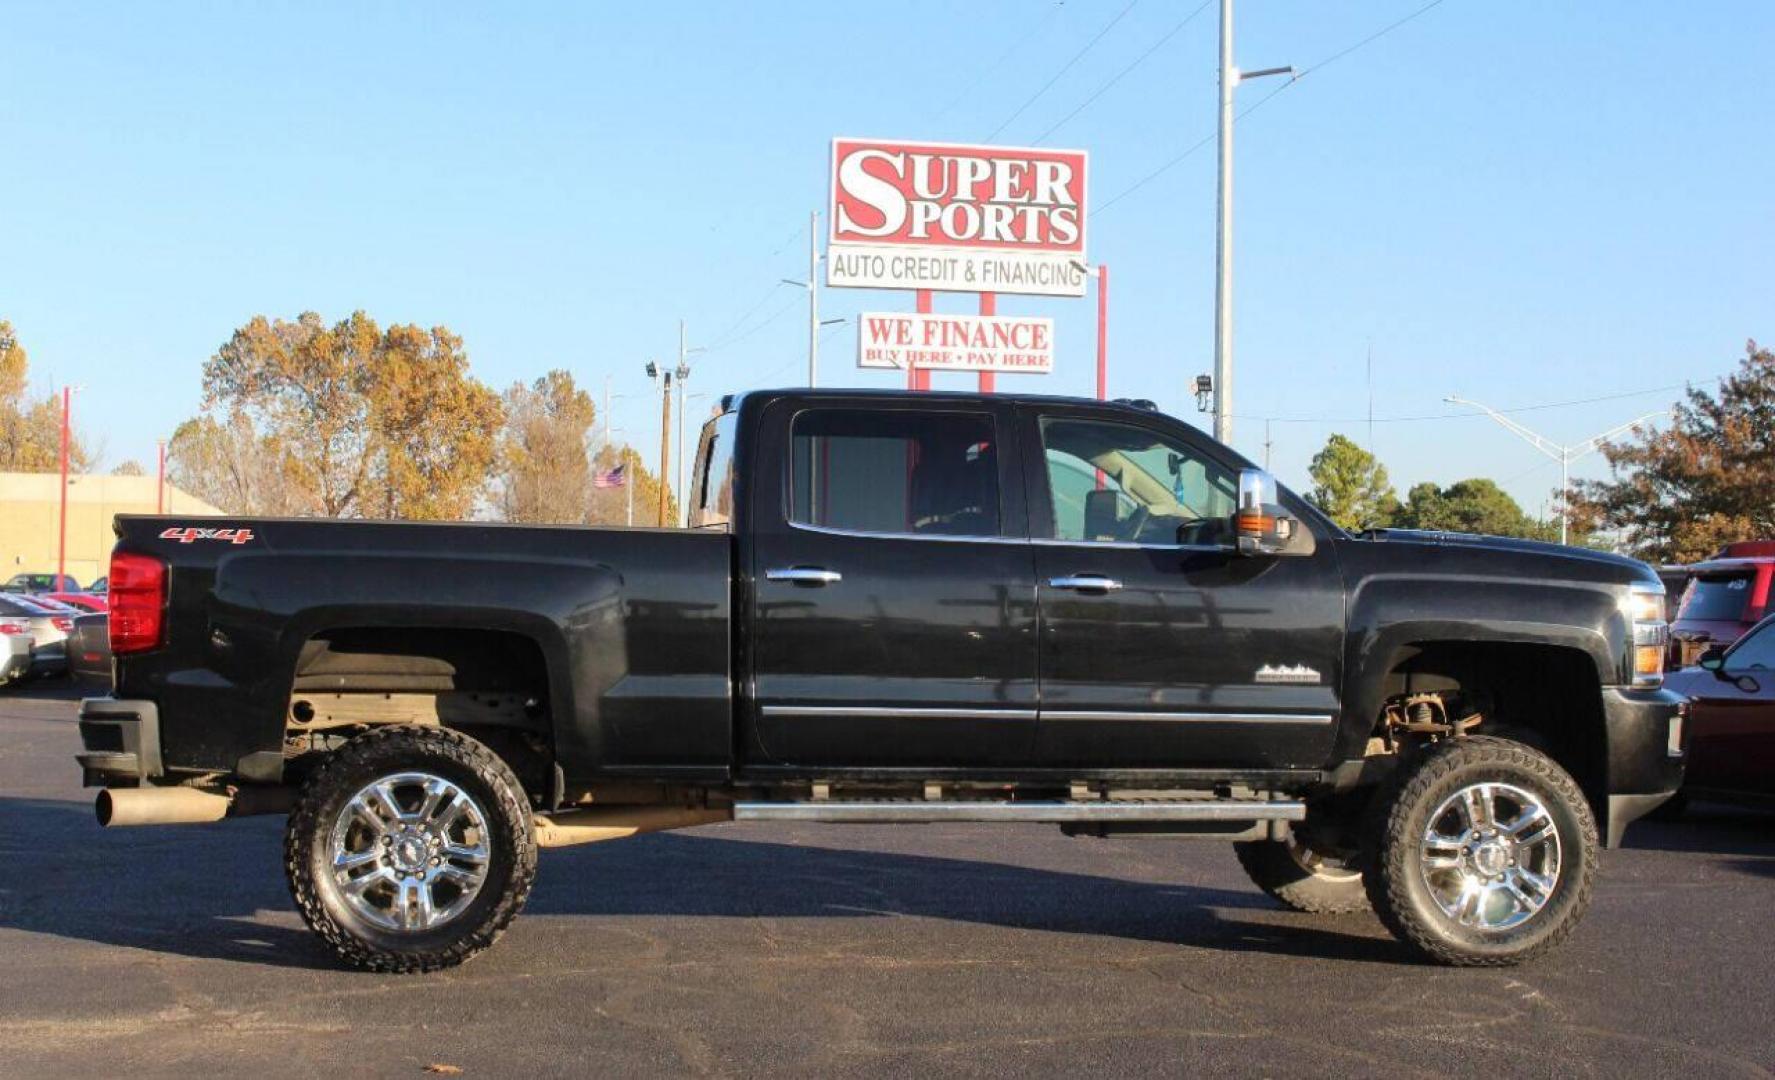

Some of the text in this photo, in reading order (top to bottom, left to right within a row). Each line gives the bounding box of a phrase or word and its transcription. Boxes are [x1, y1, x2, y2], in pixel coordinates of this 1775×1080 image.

[838, 149, 1077, 236] SUPER
[833, 254, 1082, 287] AUTO CREDIT & FINANCING
[867, 318, 1048, 350] WE FINANCE
[866, 349, 1050, 367] BUY HERE PAY HERE
